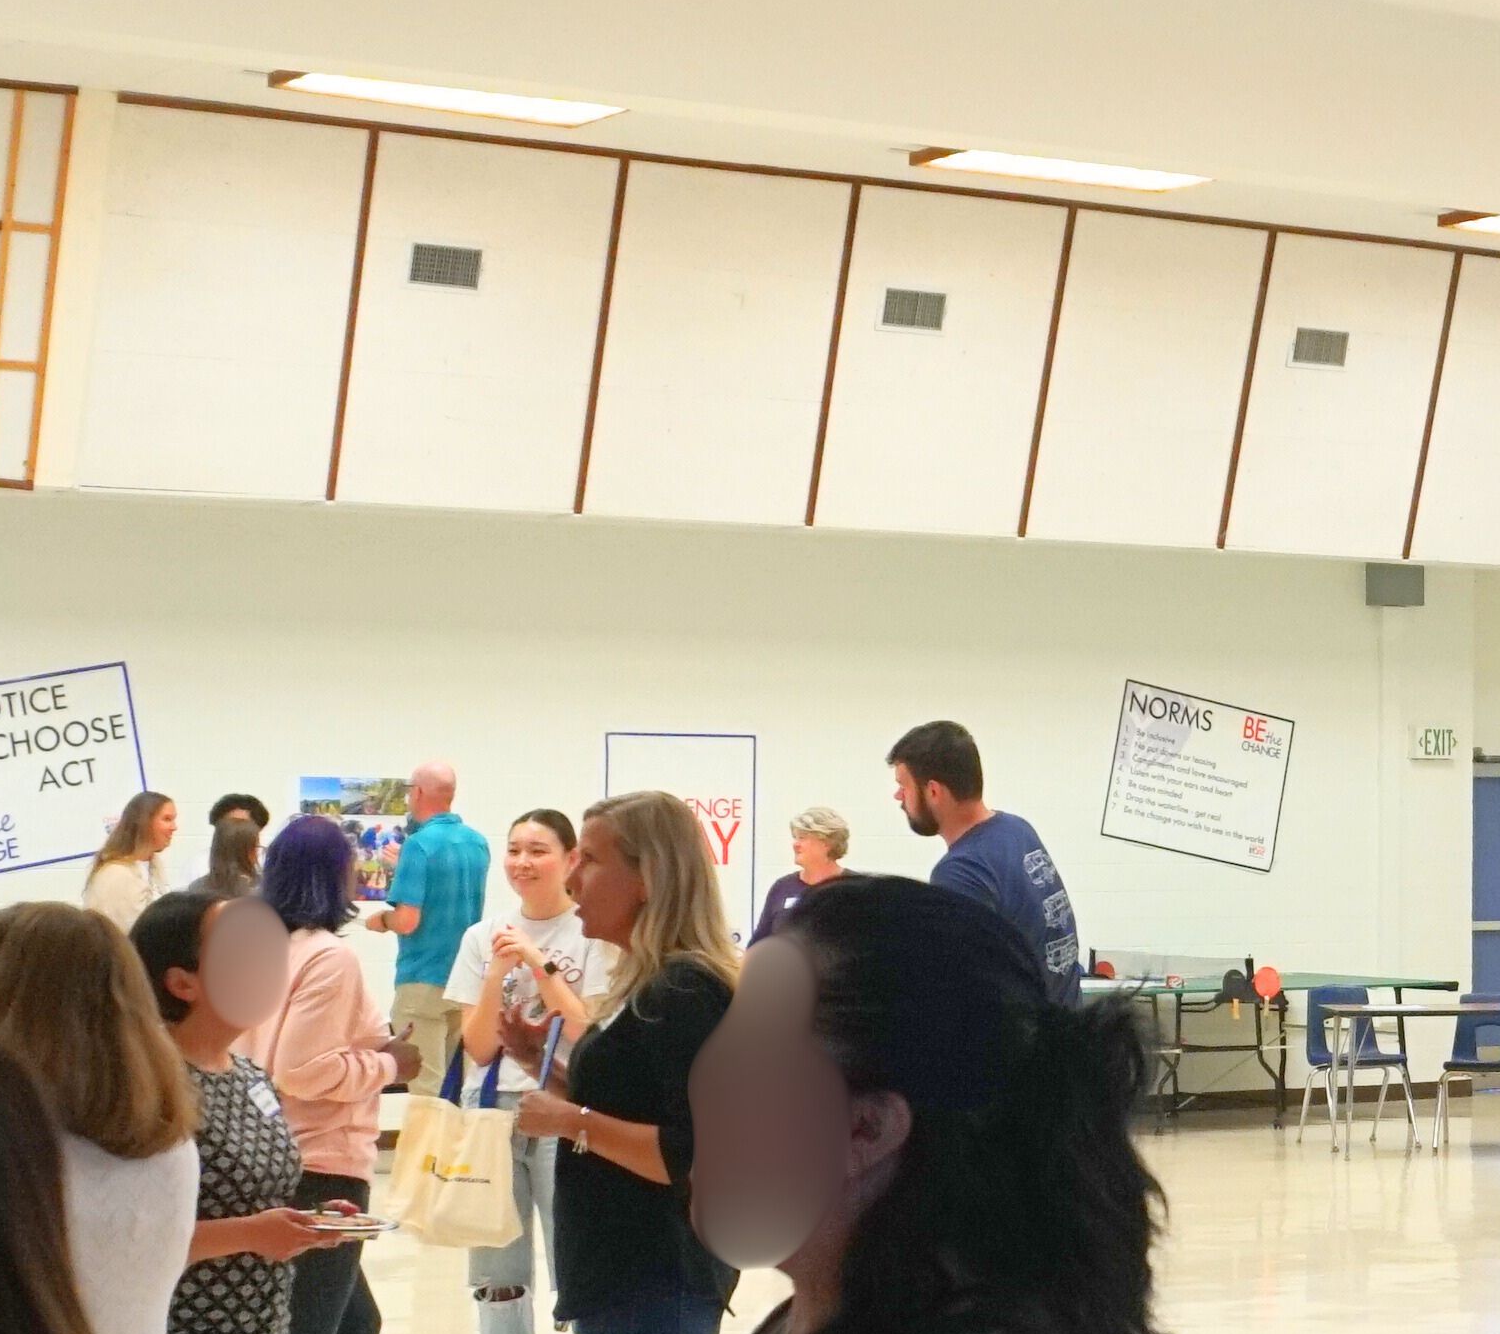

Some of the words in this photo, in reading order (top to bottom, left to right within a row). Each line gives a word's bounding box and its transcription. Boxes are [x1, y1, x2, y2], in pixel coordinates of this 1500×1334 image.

[1128, 690, 1214, 732] NORMS
[1243, 715, 1268, 743] BE
[1265, 731, 1283, 747] the
[1424, 729, 1454, 756] EXIT
[1241, 740, 1282, 759] CHANGE
[38, 757, 96, 792] ACT
